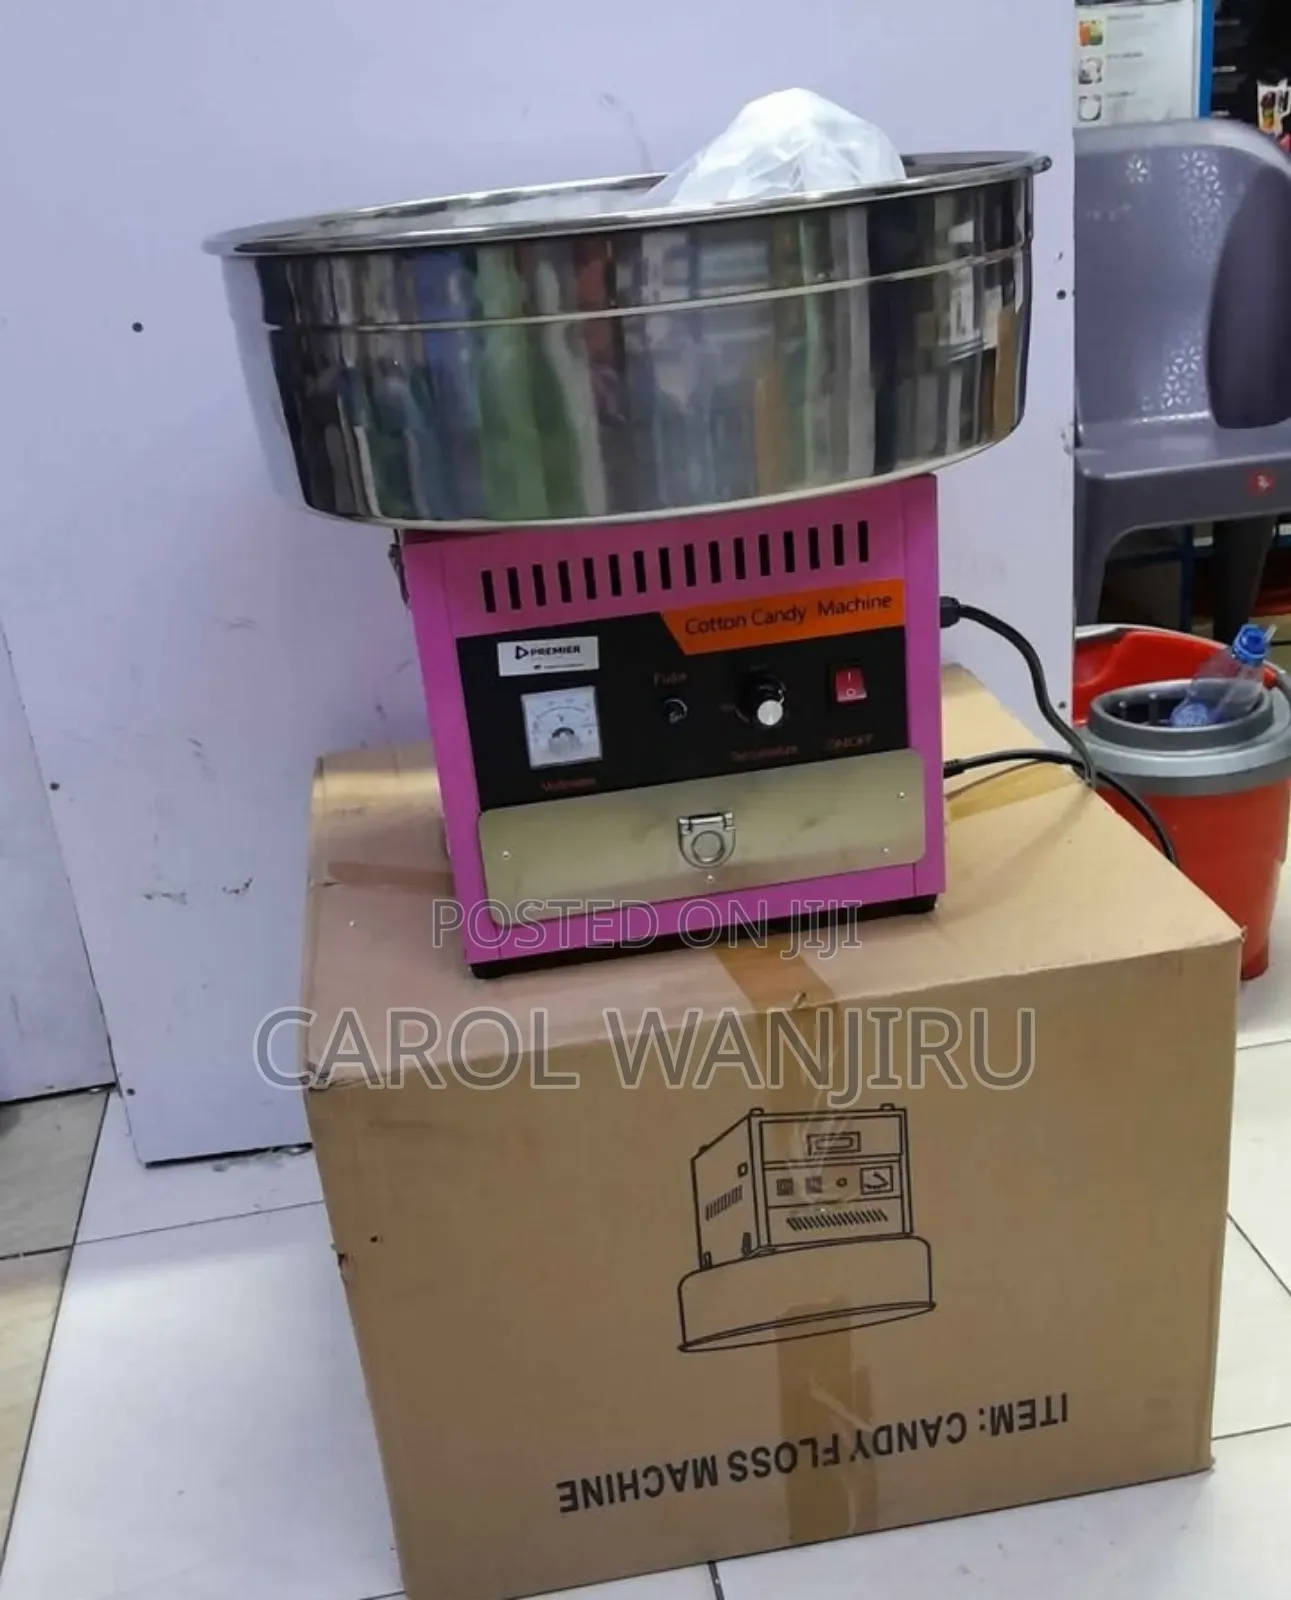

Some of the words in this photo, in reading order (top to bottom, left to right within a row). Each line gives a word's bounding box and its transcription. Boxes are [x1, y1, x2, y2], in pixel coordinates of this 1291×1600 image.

[685, 613, 747, 636] Cotton
[751, 603, 807, 626] Candy
[817, 594, 893, 618] Machine
[530, 644, 581, 657] PREMIER
[848, 1411, 968, 1464] CANDY
[977, 1391, 1069, 1438] ITEM:
[726, 1432, 842, 1483] FLOSS
[555, 1454, 720, 1514] MACHINE
